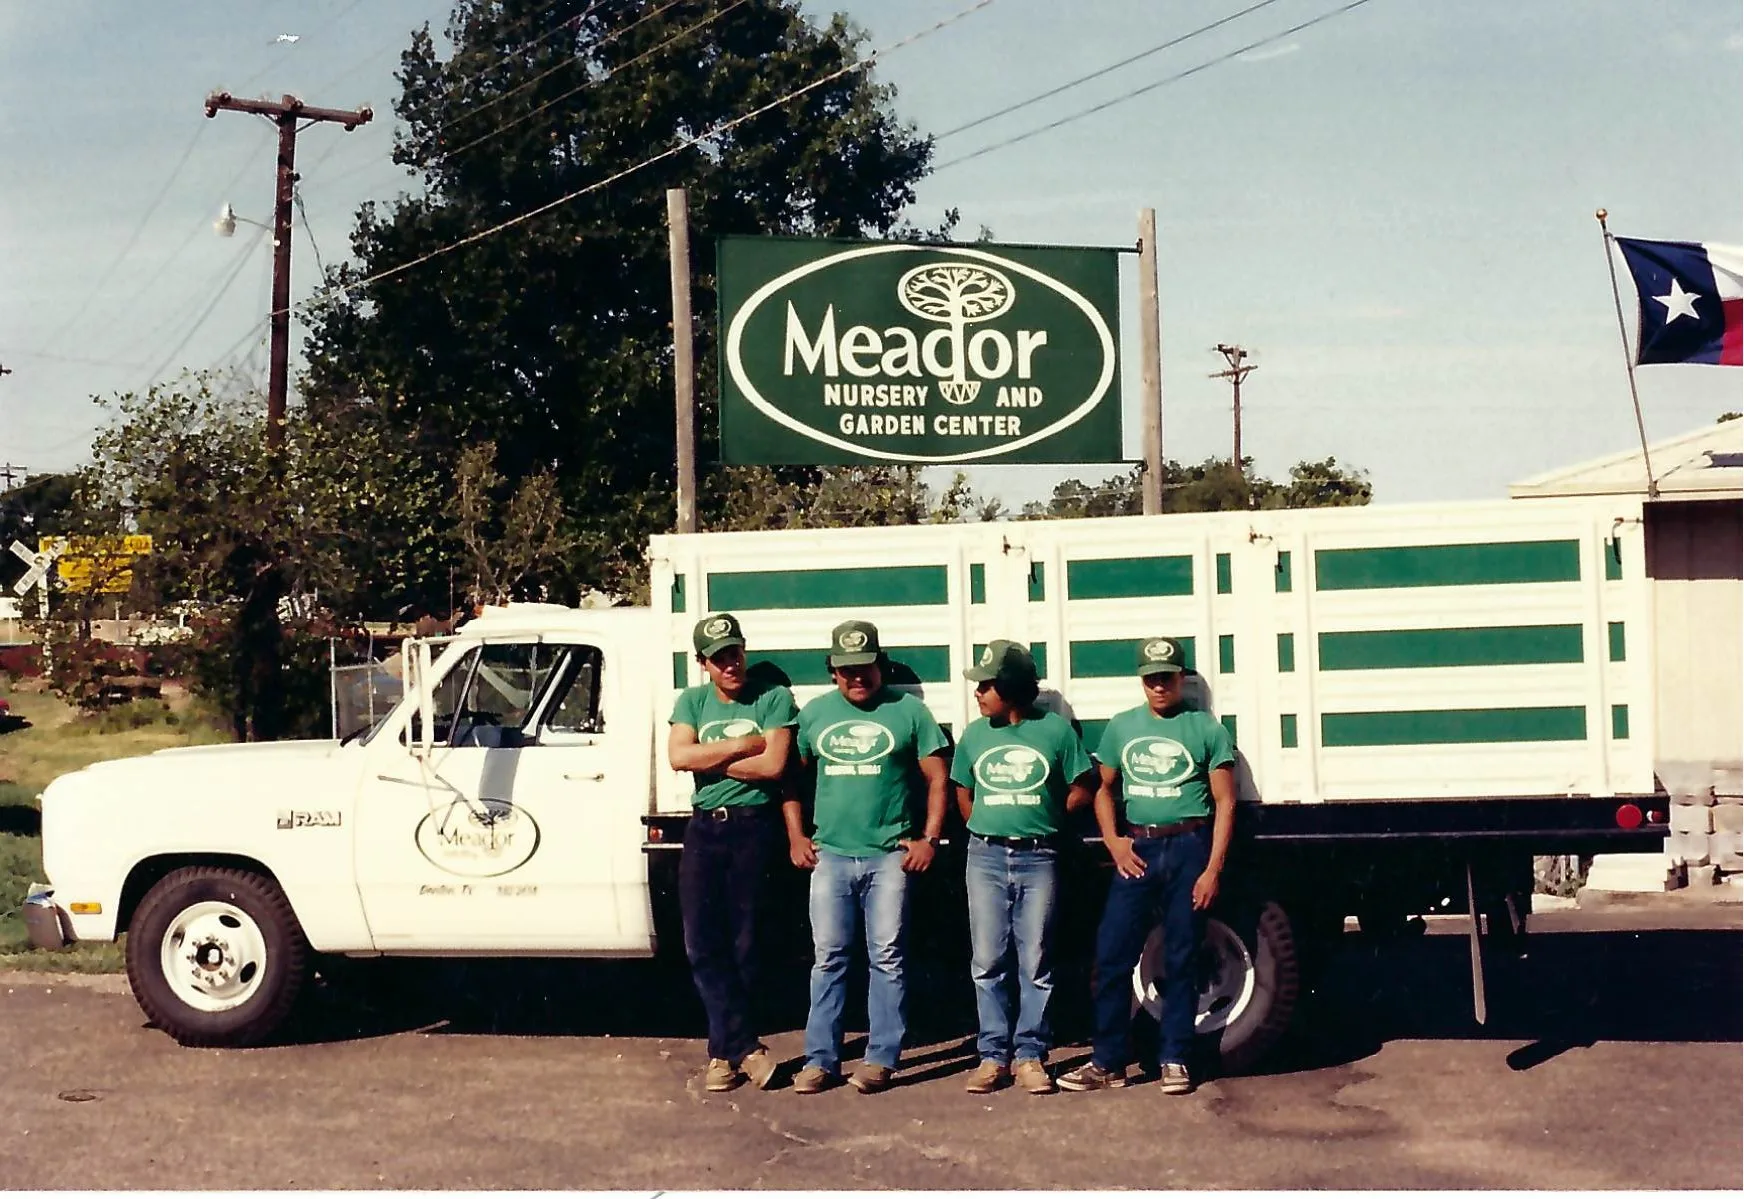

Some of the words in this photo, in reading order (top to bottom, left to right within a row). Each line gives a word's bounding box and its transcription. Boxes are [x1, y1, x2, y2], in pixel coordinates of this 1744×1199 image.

[784, 299, 1048, 382] Meador
[824, 383, 929, 407] NURSERY
[996, 386, 1043, 408] AND
[840, 412, 925, 436] GARDEN
[933, 414, 1021, 437] CENTER
[295, 809, 342, 828] RAM
